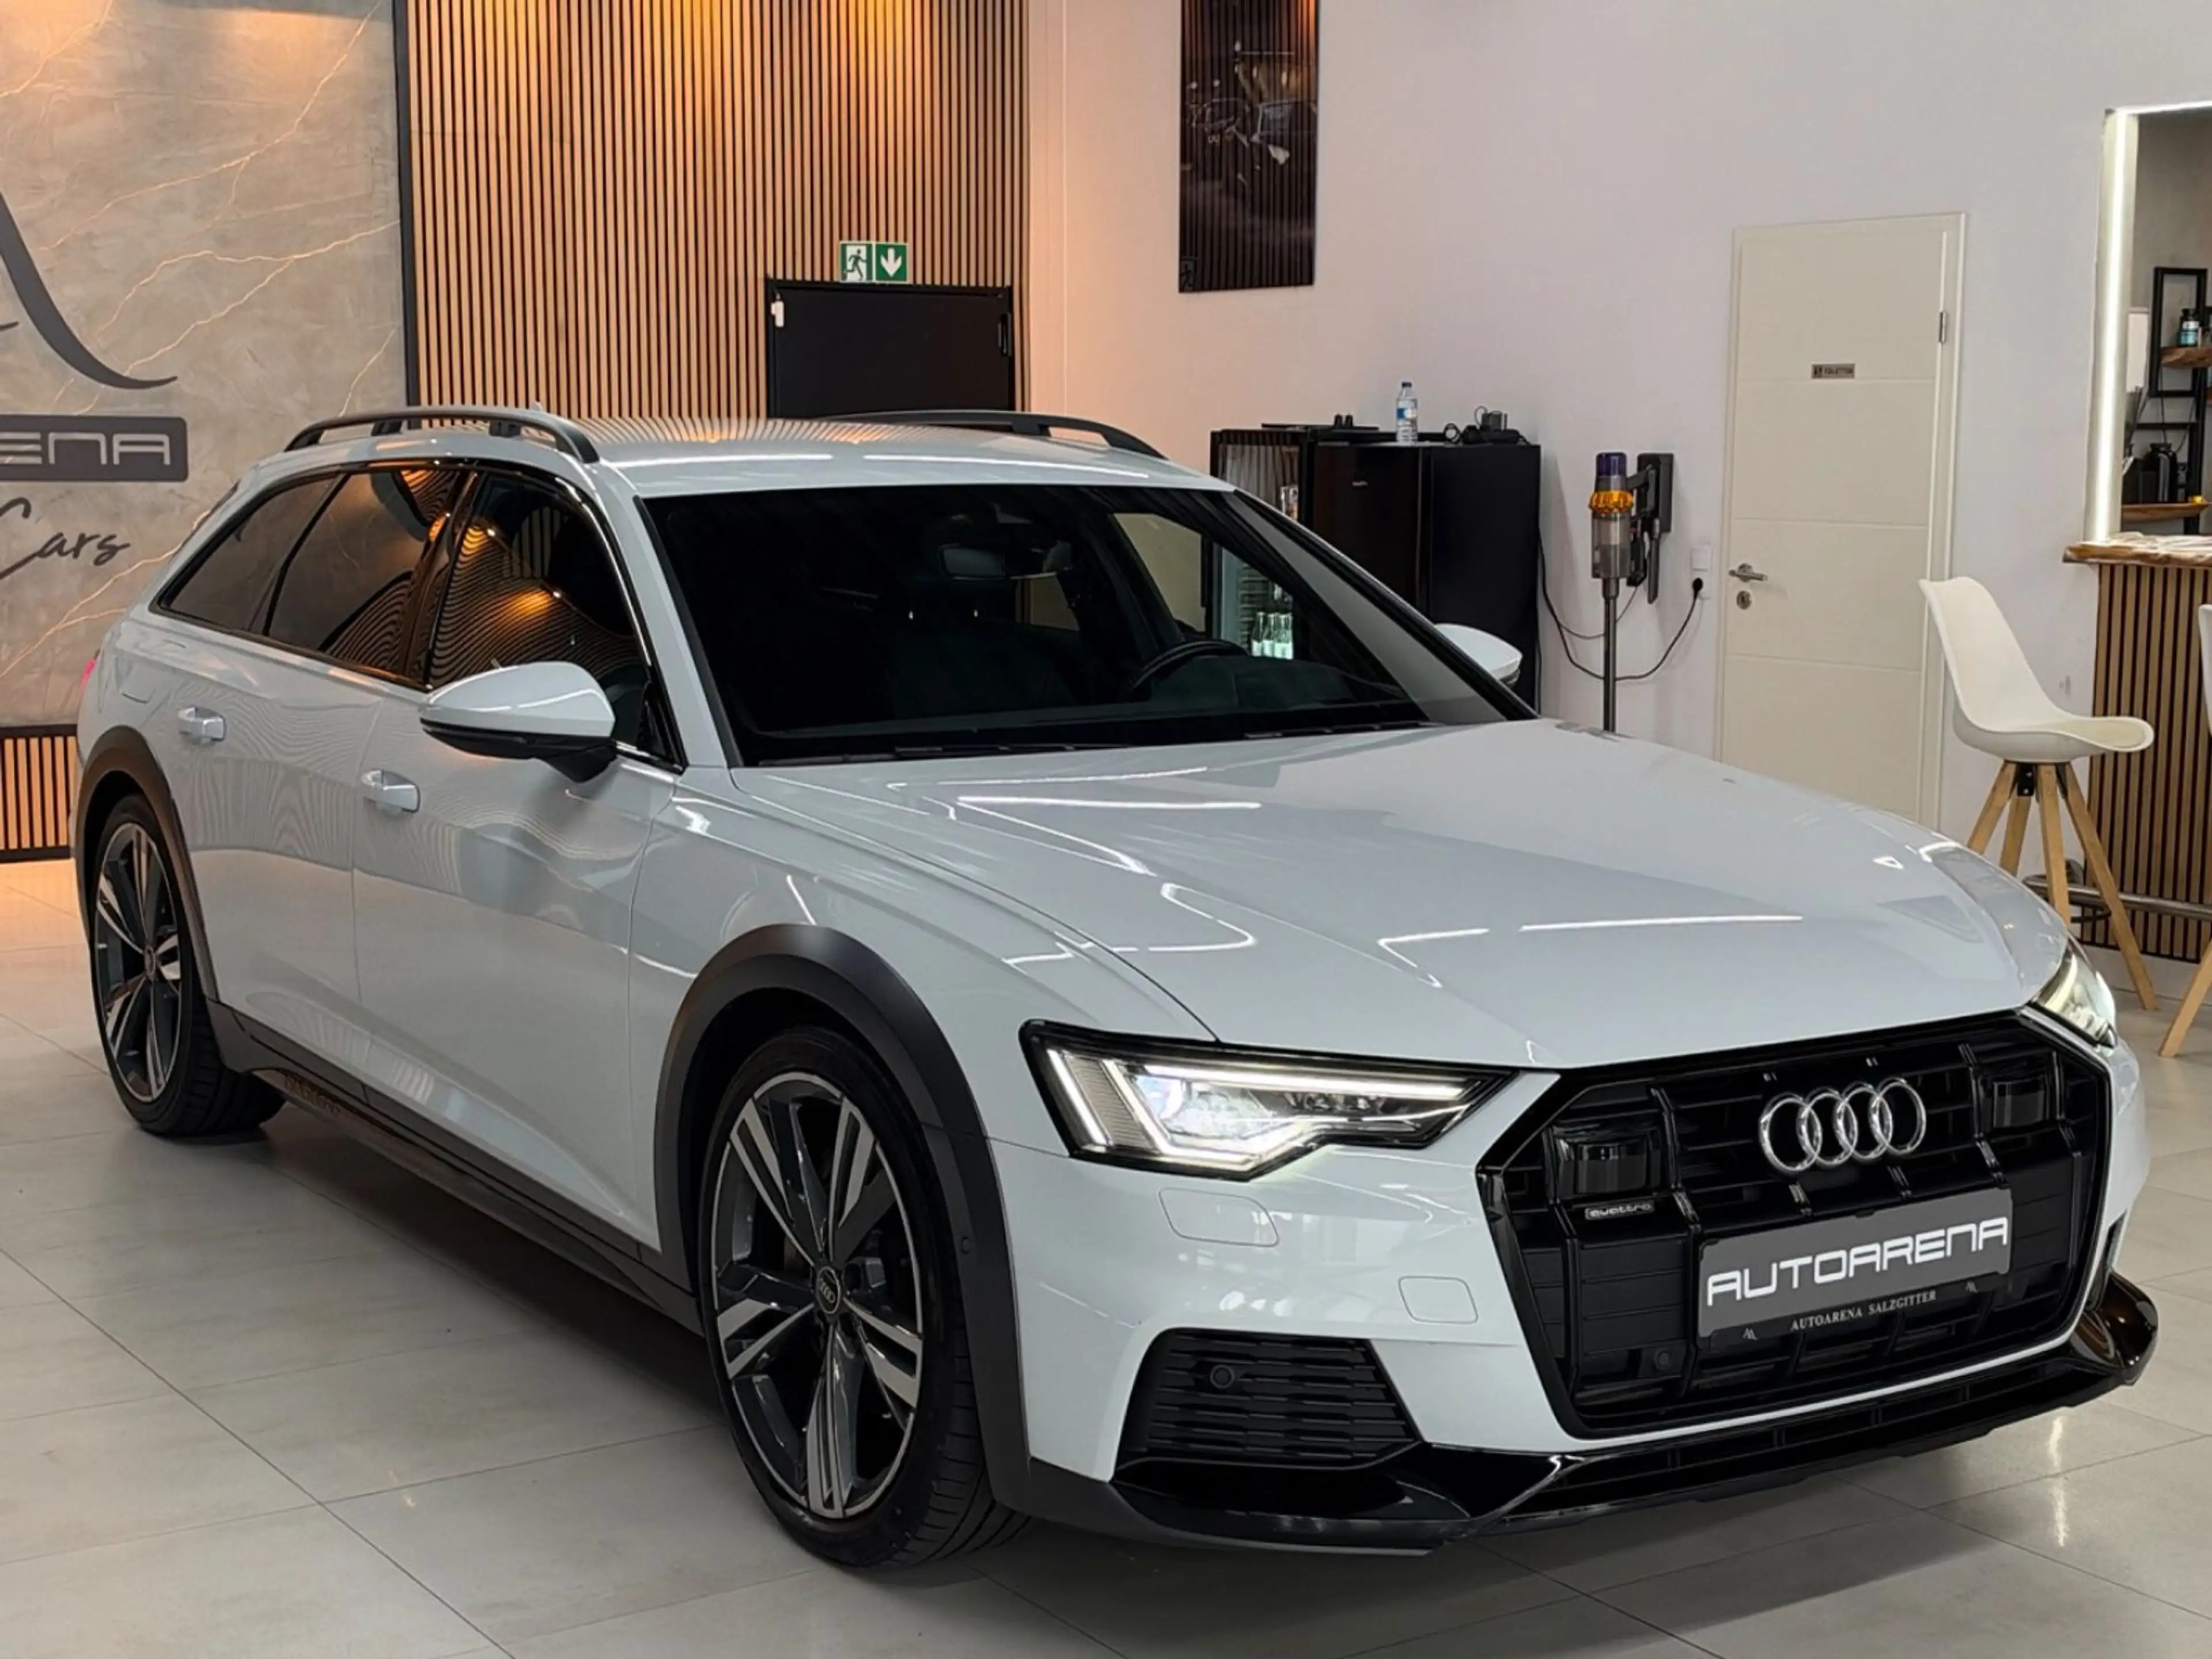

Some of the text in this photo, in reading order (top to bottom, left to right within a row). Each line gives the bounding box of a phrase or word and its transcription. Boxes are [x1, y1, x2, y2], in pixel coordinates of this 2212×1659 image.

[1590, 1203, 1652, 1217] quattro
[1707, 1217, 2008, 1306] AUTOARENA
[1790, 1290, 1937, 1332] AUTOARENA SALZGITTER
